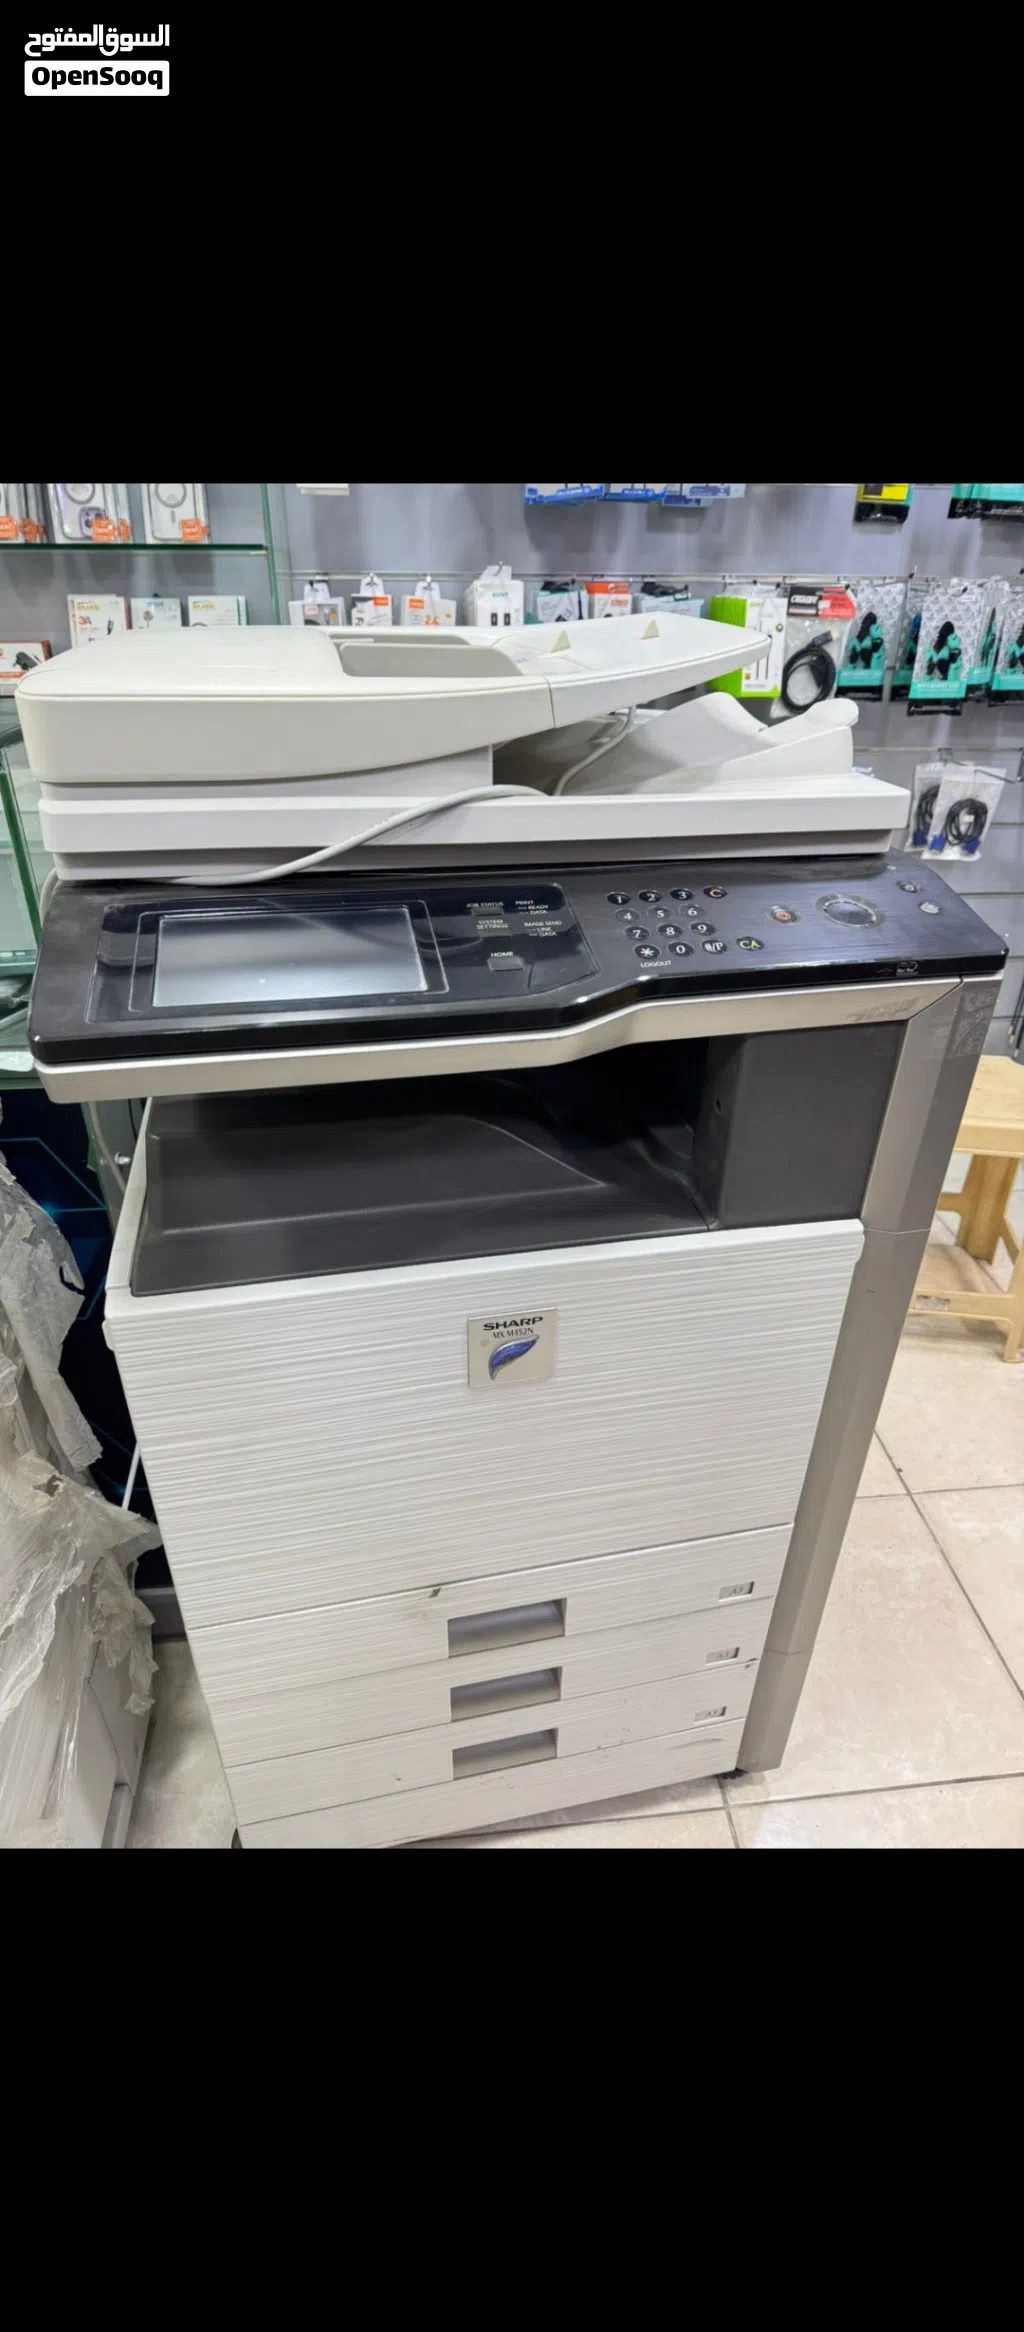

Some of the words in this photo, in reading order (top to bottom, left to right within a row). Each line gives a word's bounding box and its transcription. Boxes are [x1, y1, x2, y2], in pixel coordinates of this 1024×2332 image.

[647, 893, 656, 902] 2
[679, 891, 687, 900] 3
[709, 889, 721, 899] C
[623, 912, 632, 921] 4
[657, 909, 665, 918] 5
[688, 907, 697, 916] 6
[633, 929, 642, 939] 7
[666, 926, 675, 936] 8
[698, 924, 707, 933] 9
[676, 945, 686, 954] 0
[739, 940, 761, 950] CA
[639, 960, 672, 968] LOGOUT
[483, 1316, 544, 1331] SHARP
